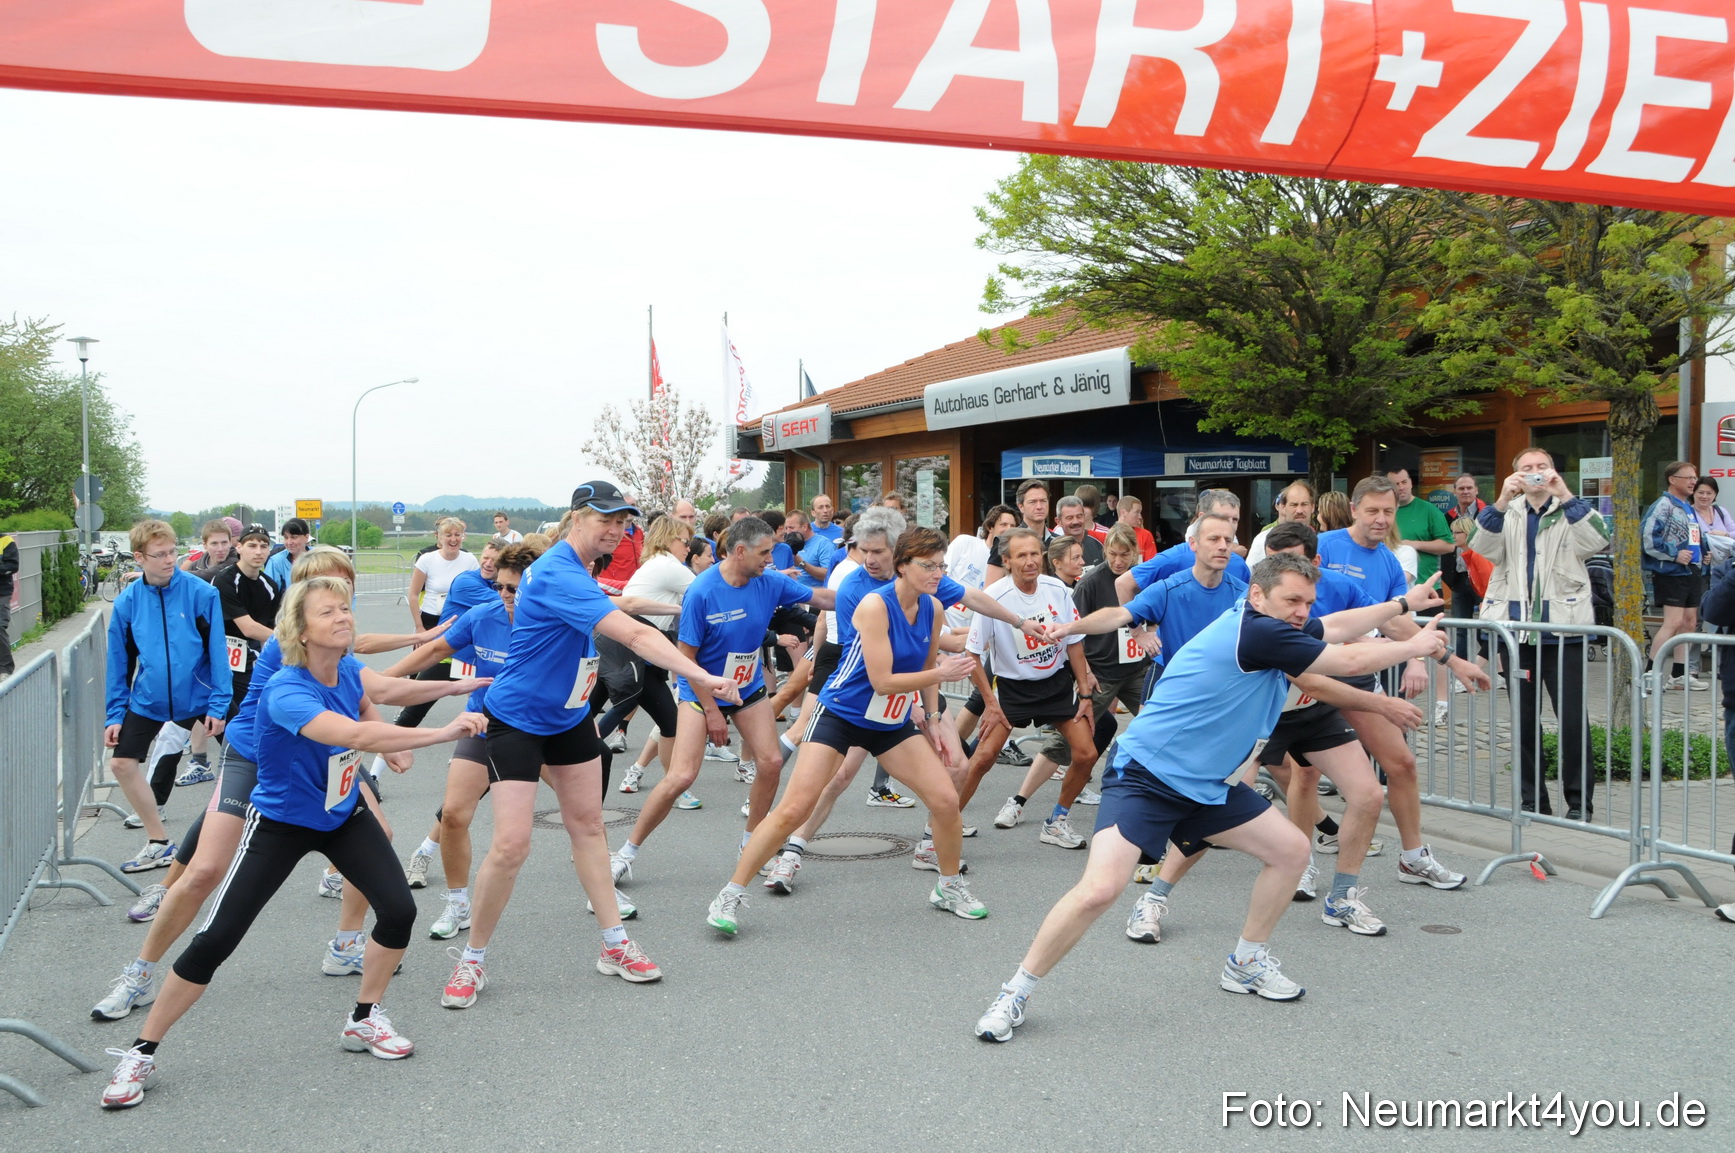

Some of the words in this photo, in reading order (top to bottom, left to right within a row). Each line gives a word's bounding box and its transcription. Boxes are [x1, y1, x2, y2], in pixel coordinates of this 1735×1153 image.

[934, 393, 989, 415] Autohaus
[994, 381, 1048, 405] Gerhart
[1053, 377, 1065, 395] &
[1070, 369, 1111, 394] Jänig
[781, 417, 819, 437] SEAT
[1059, 461, 1080, 473] Tagblatt
[1189, 459, 1234, 470] Neumarkter
[1235, 458, 1267, 471] Tagblatt
[733, 662, 754, 685] 64
[883, 693, 907, 719] 10
